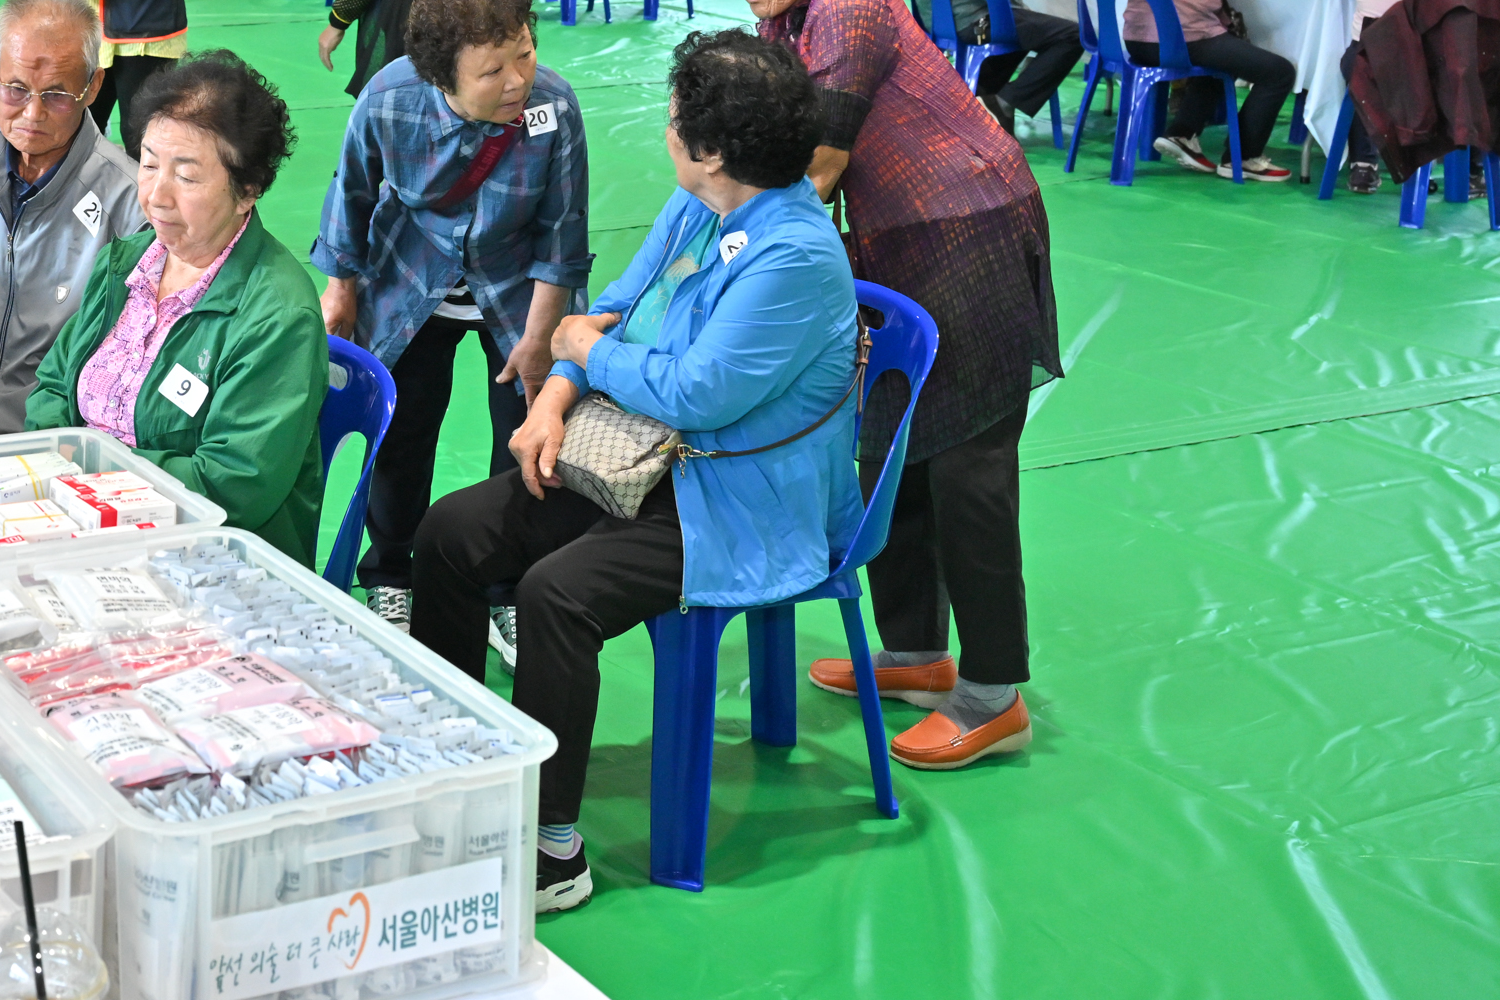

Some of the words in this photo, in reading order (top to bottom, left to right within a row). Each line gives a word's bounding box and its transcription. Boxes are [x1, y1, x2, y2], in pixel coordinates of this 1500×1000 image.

[528, 110, 549, 128] 20
[177, 379, 192, 396] 9
[210, 952, 242, 993] 앞선
[249, 943, 281, 984] 의술
[286, 937, 302, 962] 더
[309, 936, 321, 969] 큰
[327, 925, 361, 957] 사랑
[378, 891, 499, 951] 서울아산병원
